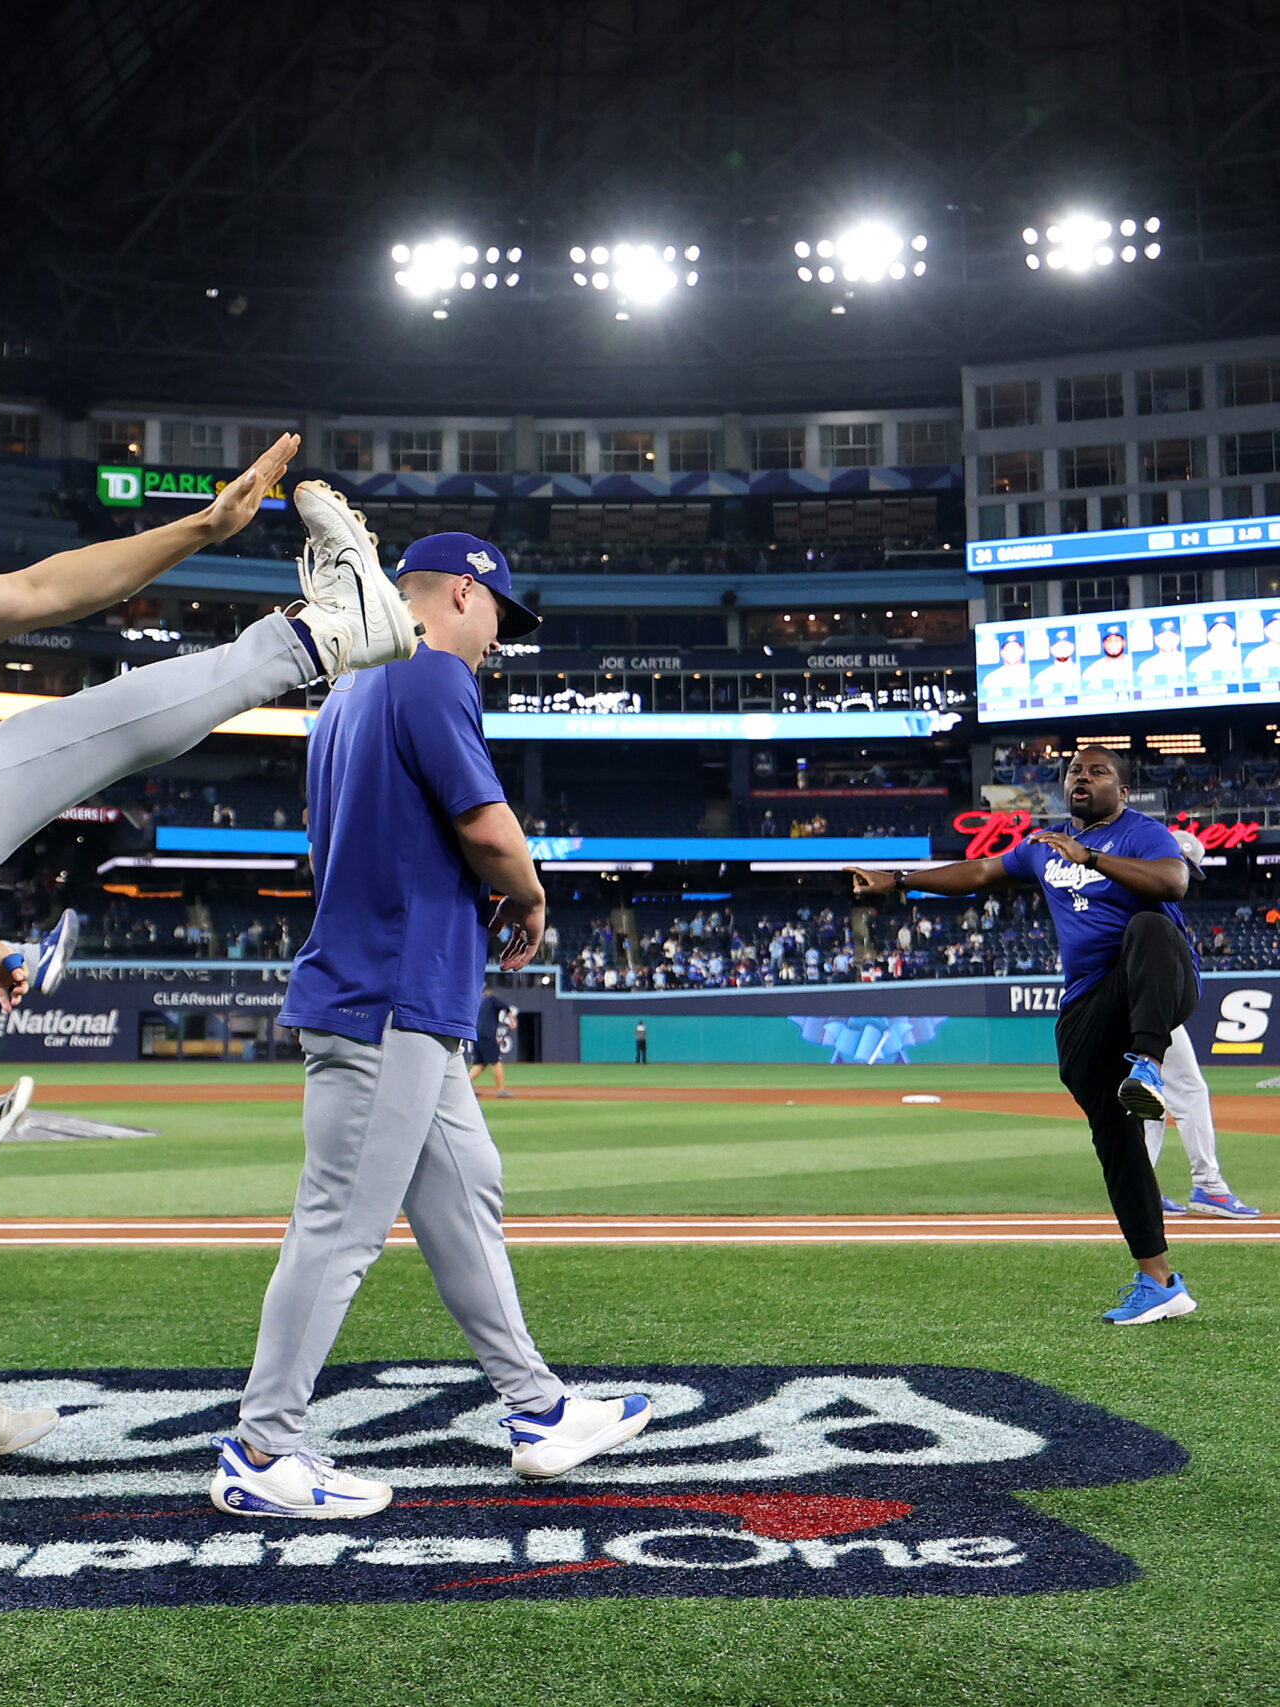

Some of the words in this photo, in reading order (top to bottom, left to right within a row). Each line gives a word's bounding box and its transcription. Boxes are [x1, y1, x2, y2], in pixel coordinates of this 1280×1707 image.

[101, 472, 139, 500] TD
[144, 472, 214, 494] PARK
[599, 657, 624, 669] JOE
[631, 656, 681, 670] CARTER
[806, 654, 863, 668] GEORGE
[868, 653, 899, 667] BELL
[6, 1009, 119, 1035] National
[1214, 989, 1273, 1042] S
[43, 1034, 69, 1047] Car
[70, 1034, 112, 1048] Rental
